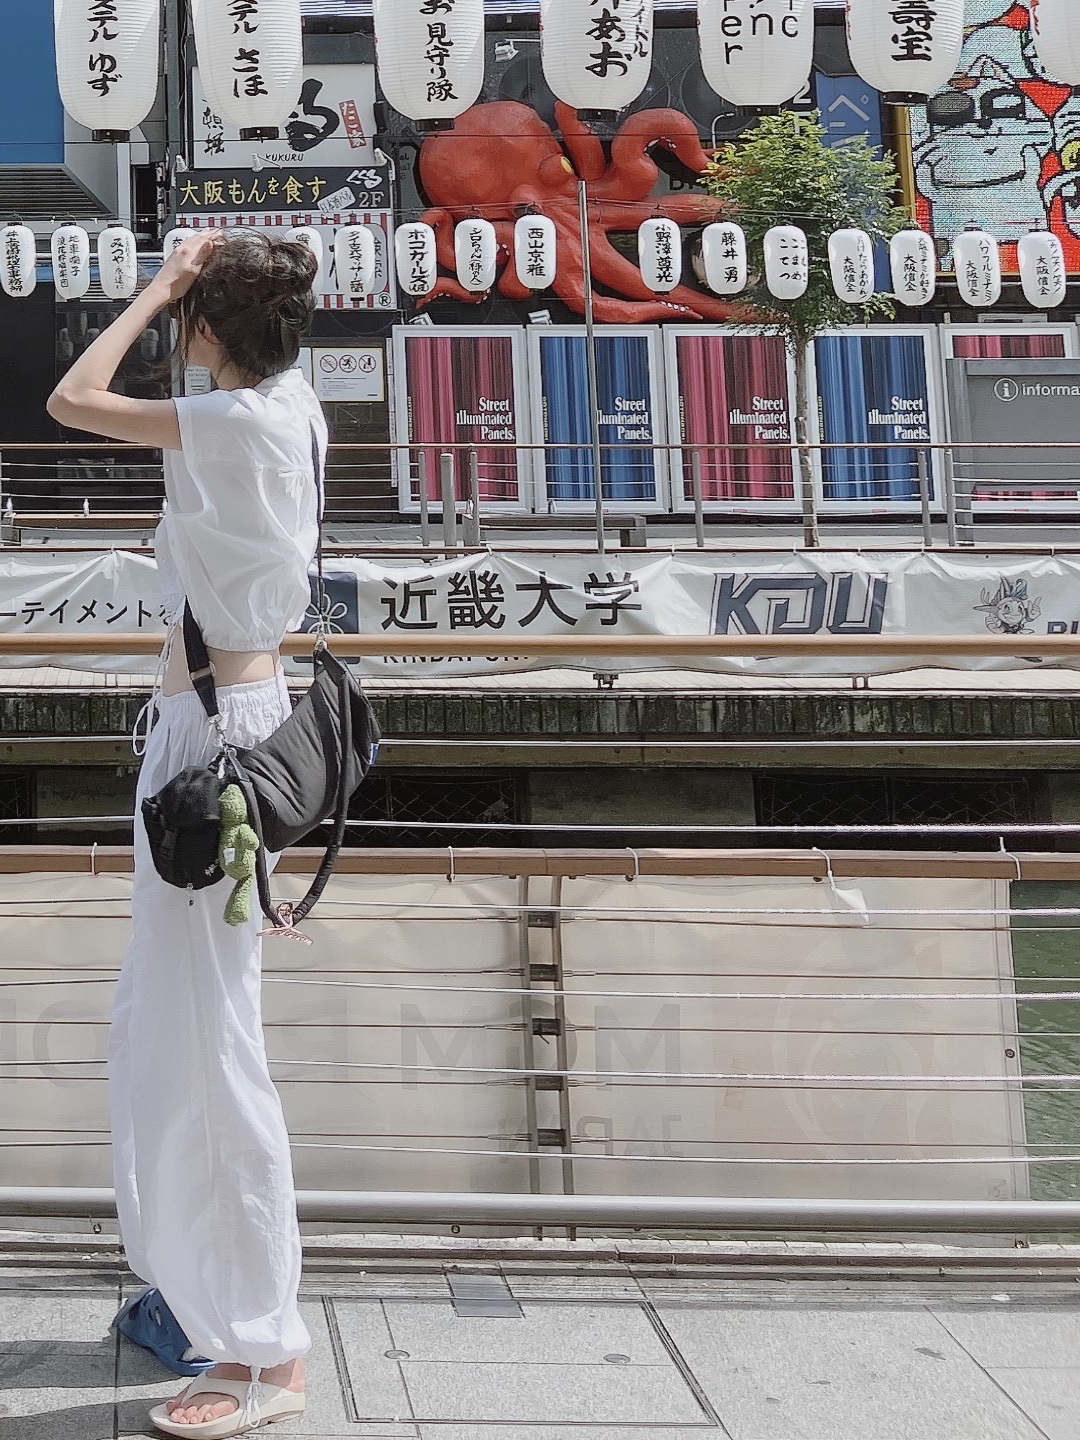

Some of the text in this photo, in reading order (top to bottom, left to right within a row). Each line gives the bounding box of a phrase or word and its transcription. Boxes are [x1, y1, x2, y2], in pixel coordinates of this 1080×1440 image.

[179, 174, 328, 207] 大阪もんを食す
[358, 191, 385, 208] 2F
[1022, 382, 1080, 397] informa
[479, 396, 510, 411] Street
[614, 396, 646, 411] Street
[752, 396, 784, 411] Street
[891, 396, 923, 411] Street
[380, 570, 643, 631] 近畿大学
